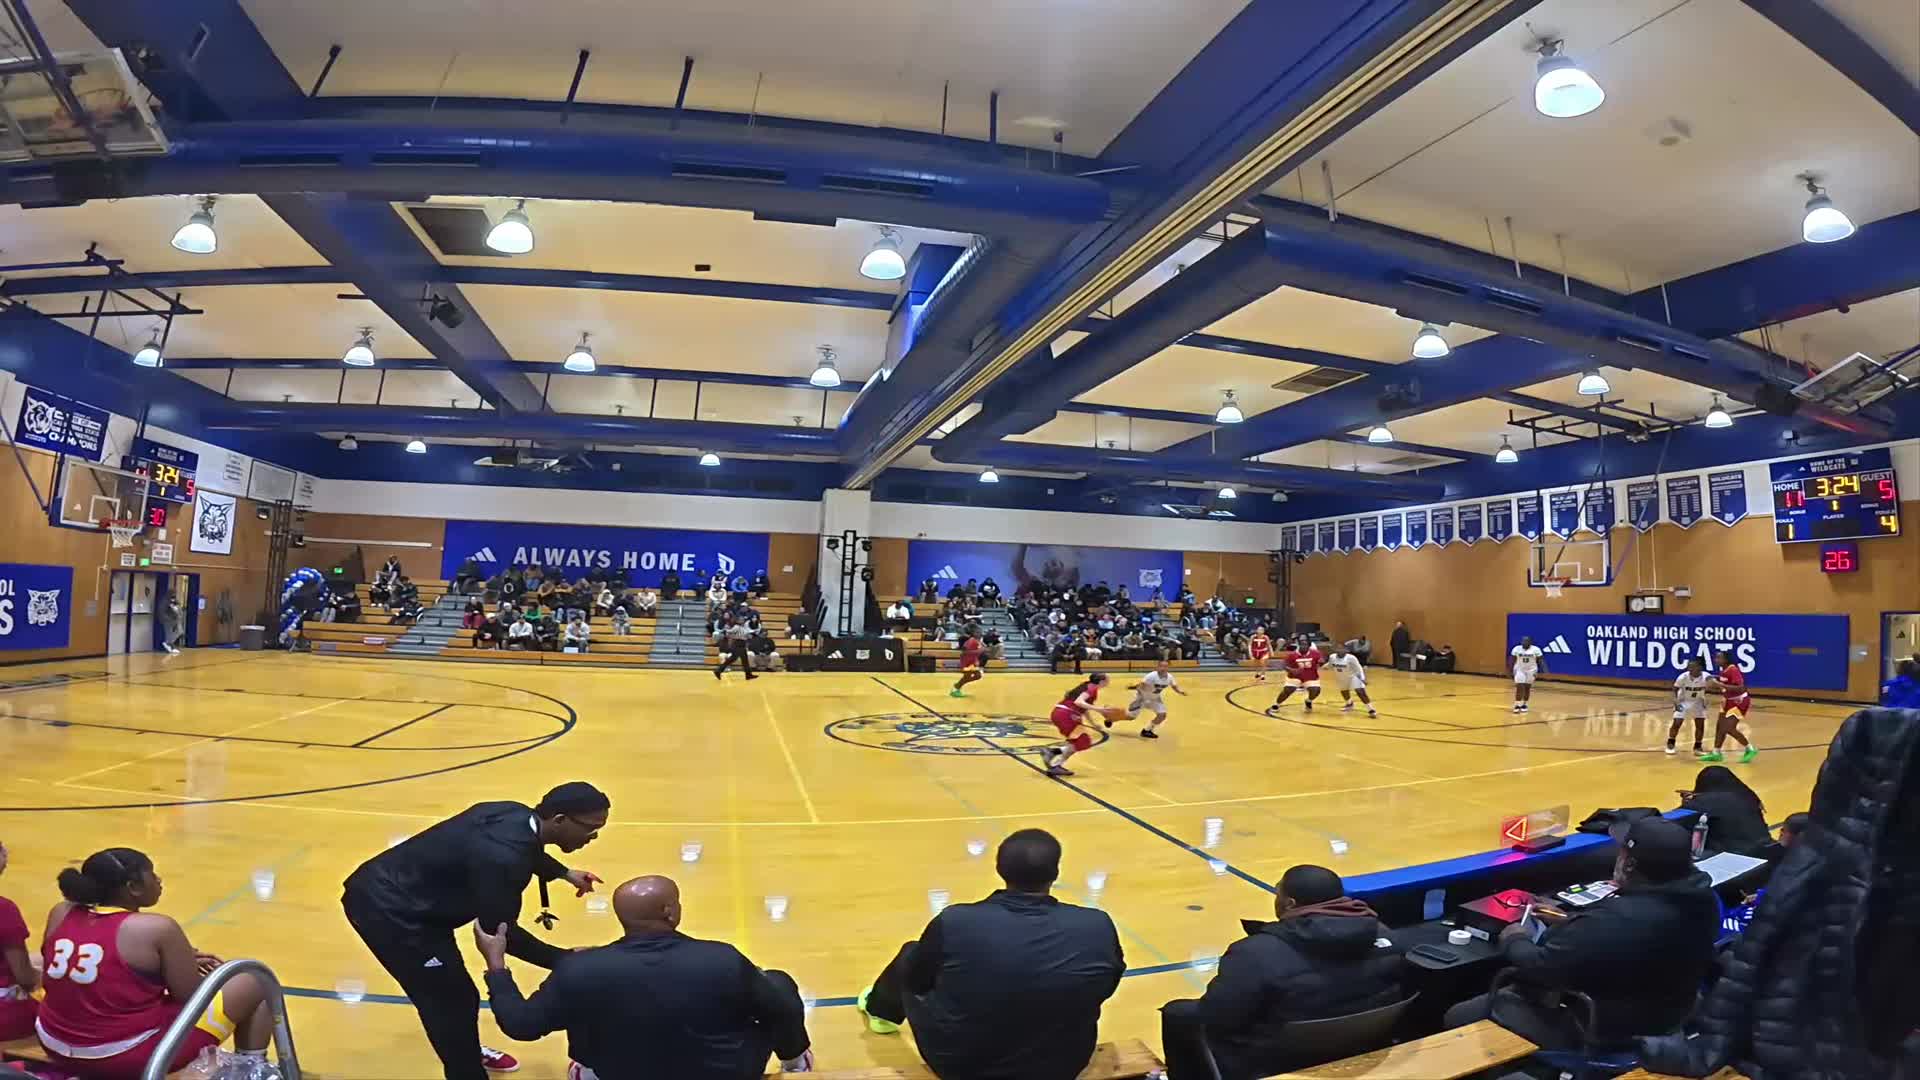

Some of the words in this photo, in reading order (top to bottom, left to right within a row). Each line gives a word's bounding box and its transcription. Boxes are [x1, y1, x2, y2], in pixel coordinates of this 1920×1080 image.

[1811, 463, 1846, 472] WILDCATS
[1816, 475, 1858, 497] 3:24
[1860, 473, 1892, 482] GUEST
[1773, 482, 1800, 492] HOME
[1878, 480, 1894, 500] 5
[1786, 491, 1803, 507] 11
[1788, 524, 1794, 540] 1
[1880, 515, 1896, 533] 4
[513, 546, 612, 568] ALWAYS
[623, 550, 696, 571] HOME
[1825, 551, 1850, 570] 26
[1587, 625, 1648, 639] OAKLAND
[1654, 626, 1689, 640] HIGH
[1694, 627, 1756, 641] SCHOOL
[47, 938, 103, 984] 33
